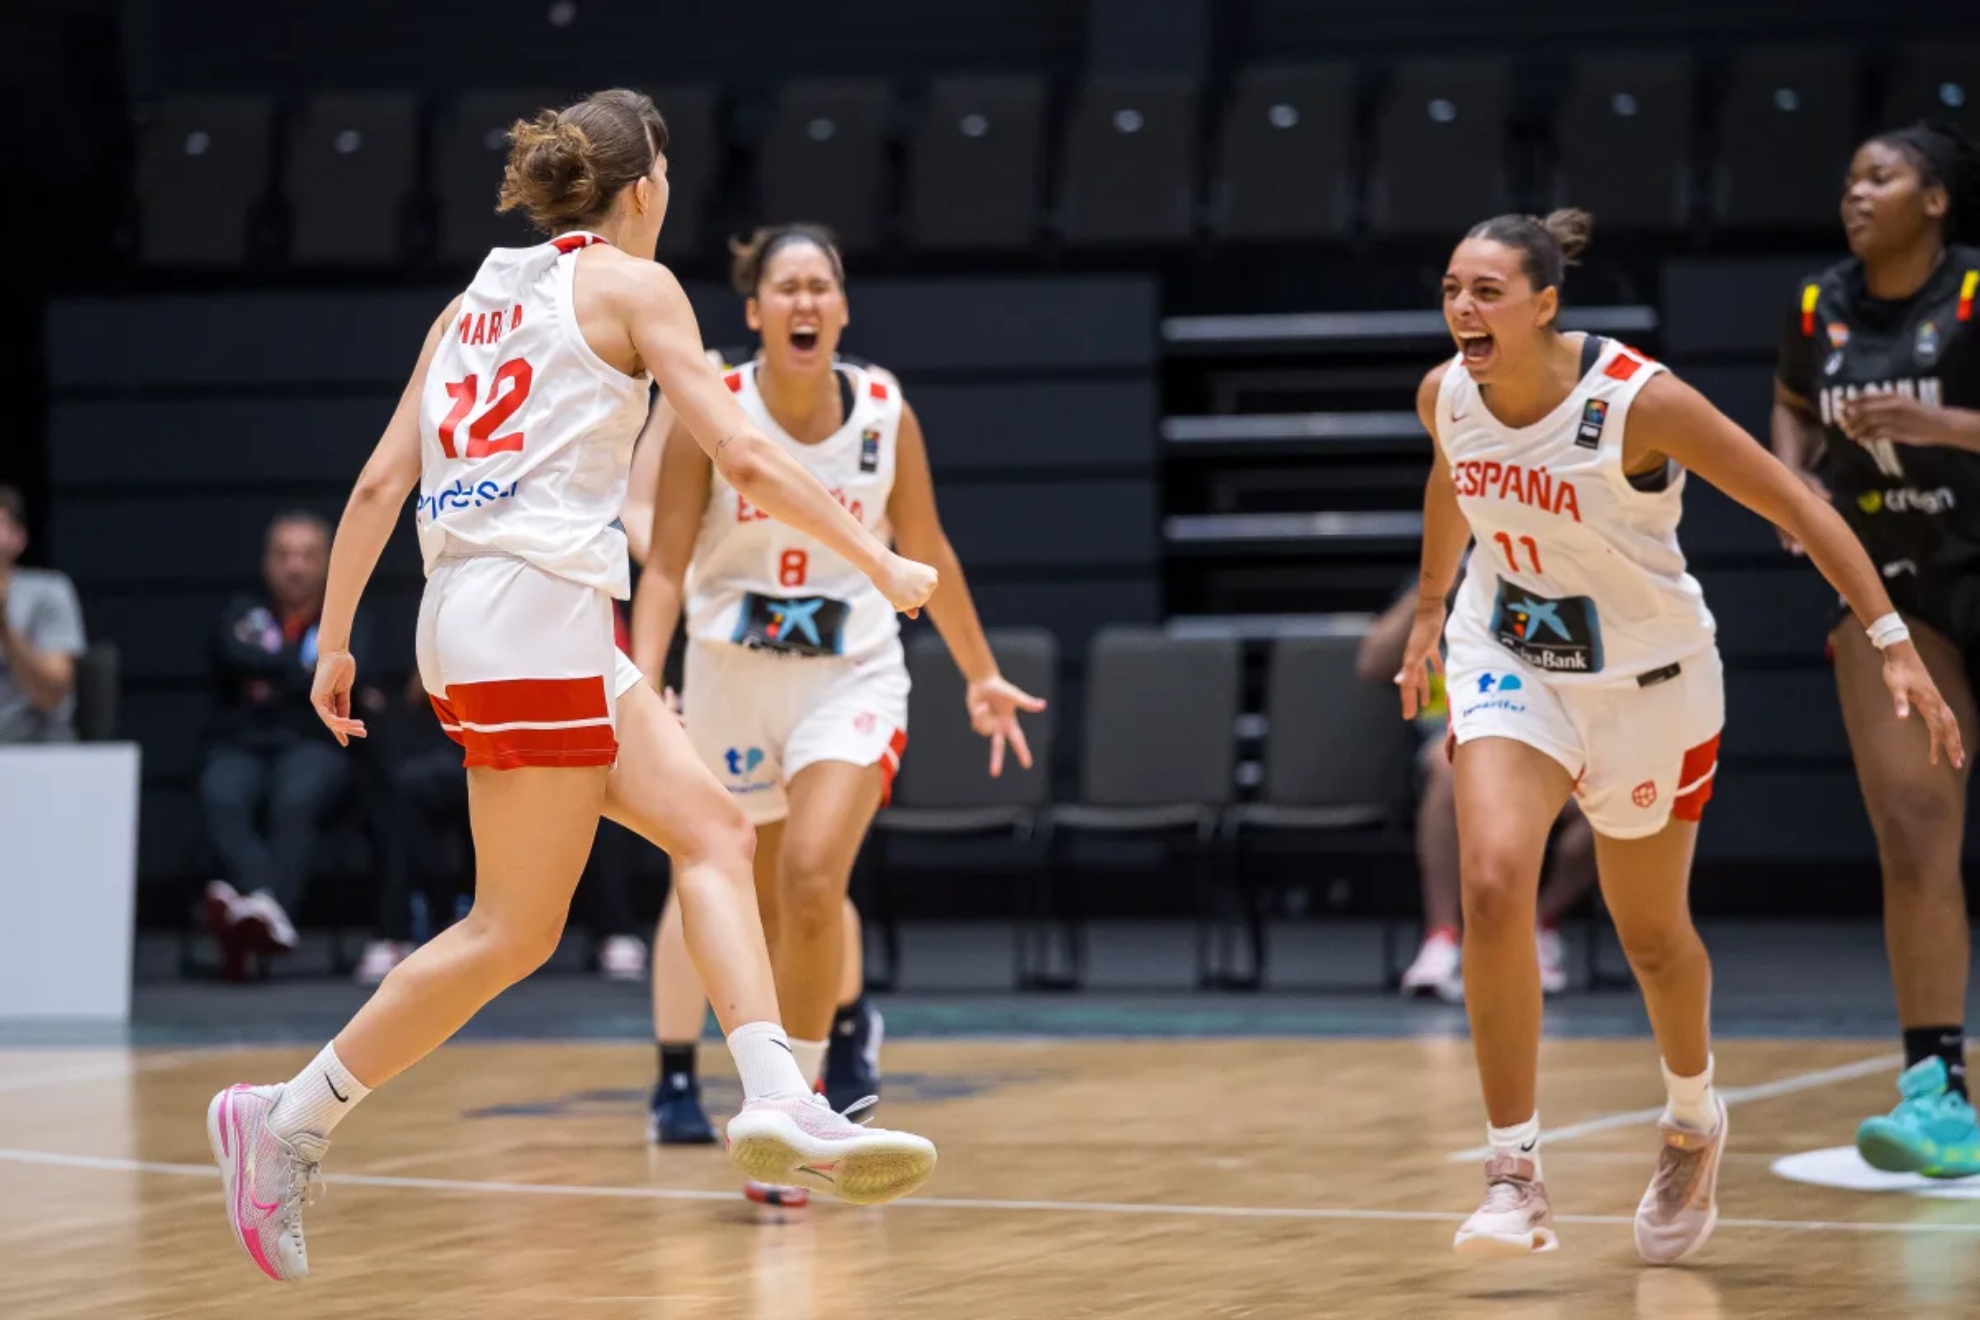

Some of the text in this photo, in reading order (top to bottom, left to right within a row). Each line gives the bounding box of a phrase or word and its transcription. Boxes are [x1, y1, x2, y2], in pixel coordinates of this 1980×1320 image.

[459, 304, 522, 345] MARA
[438, 357, 533, 459] 12
[1454, 461, 1582, 523] ESPAÑA
[779, 548, 808, 588] 8
[1494, 531, 1542, 574] 11
